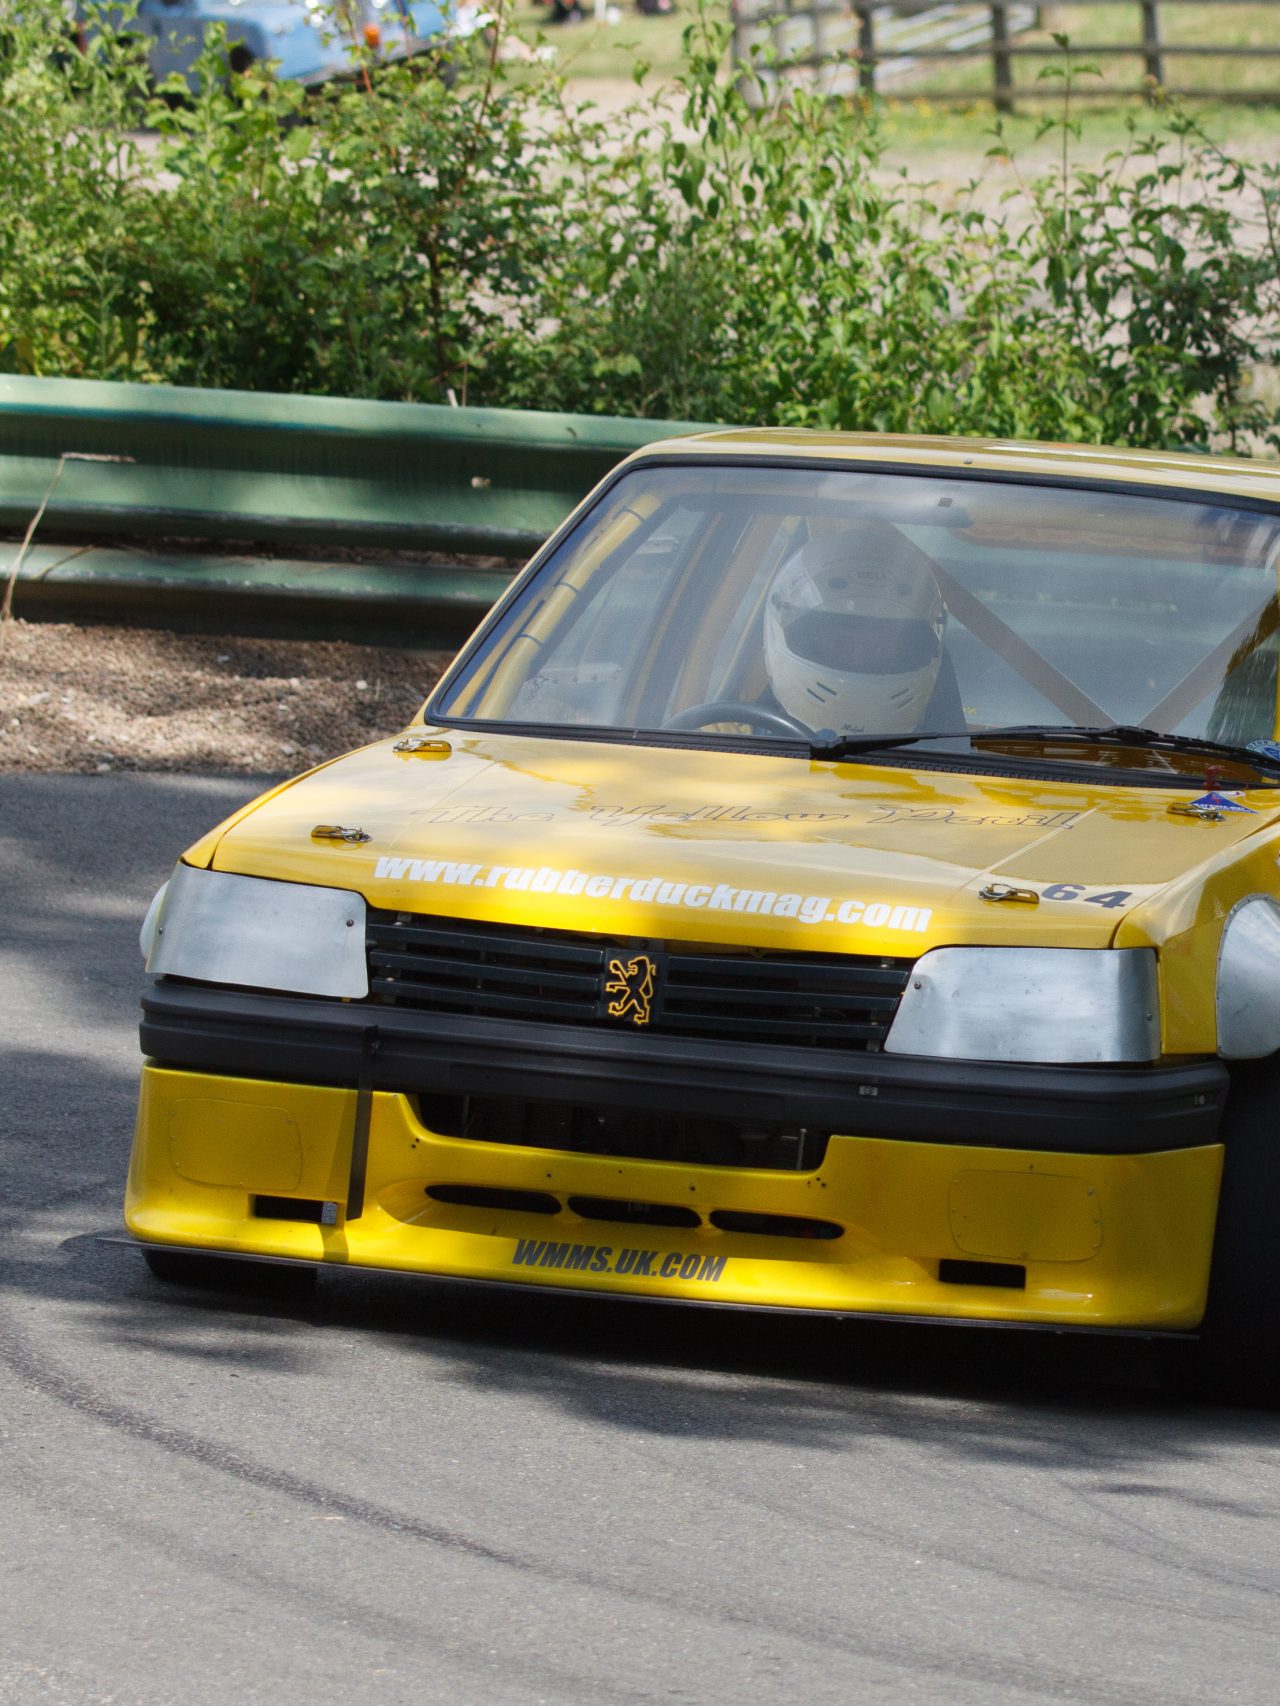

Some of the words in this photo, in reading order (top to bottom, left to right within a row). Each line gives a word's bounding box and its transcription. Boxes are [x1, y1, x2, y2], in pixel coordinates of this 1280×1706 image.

[410, 805, 555, 824] The
[590, 804, 850, 826] Yellow
[866, 804, 1074, 830] Peril
[374, 856, 932, 933] www.rubberduckmag.com
[1041, 883, 1133, 909] 64
[511, 1239, 728, 1282] WMMS.UK.COM
